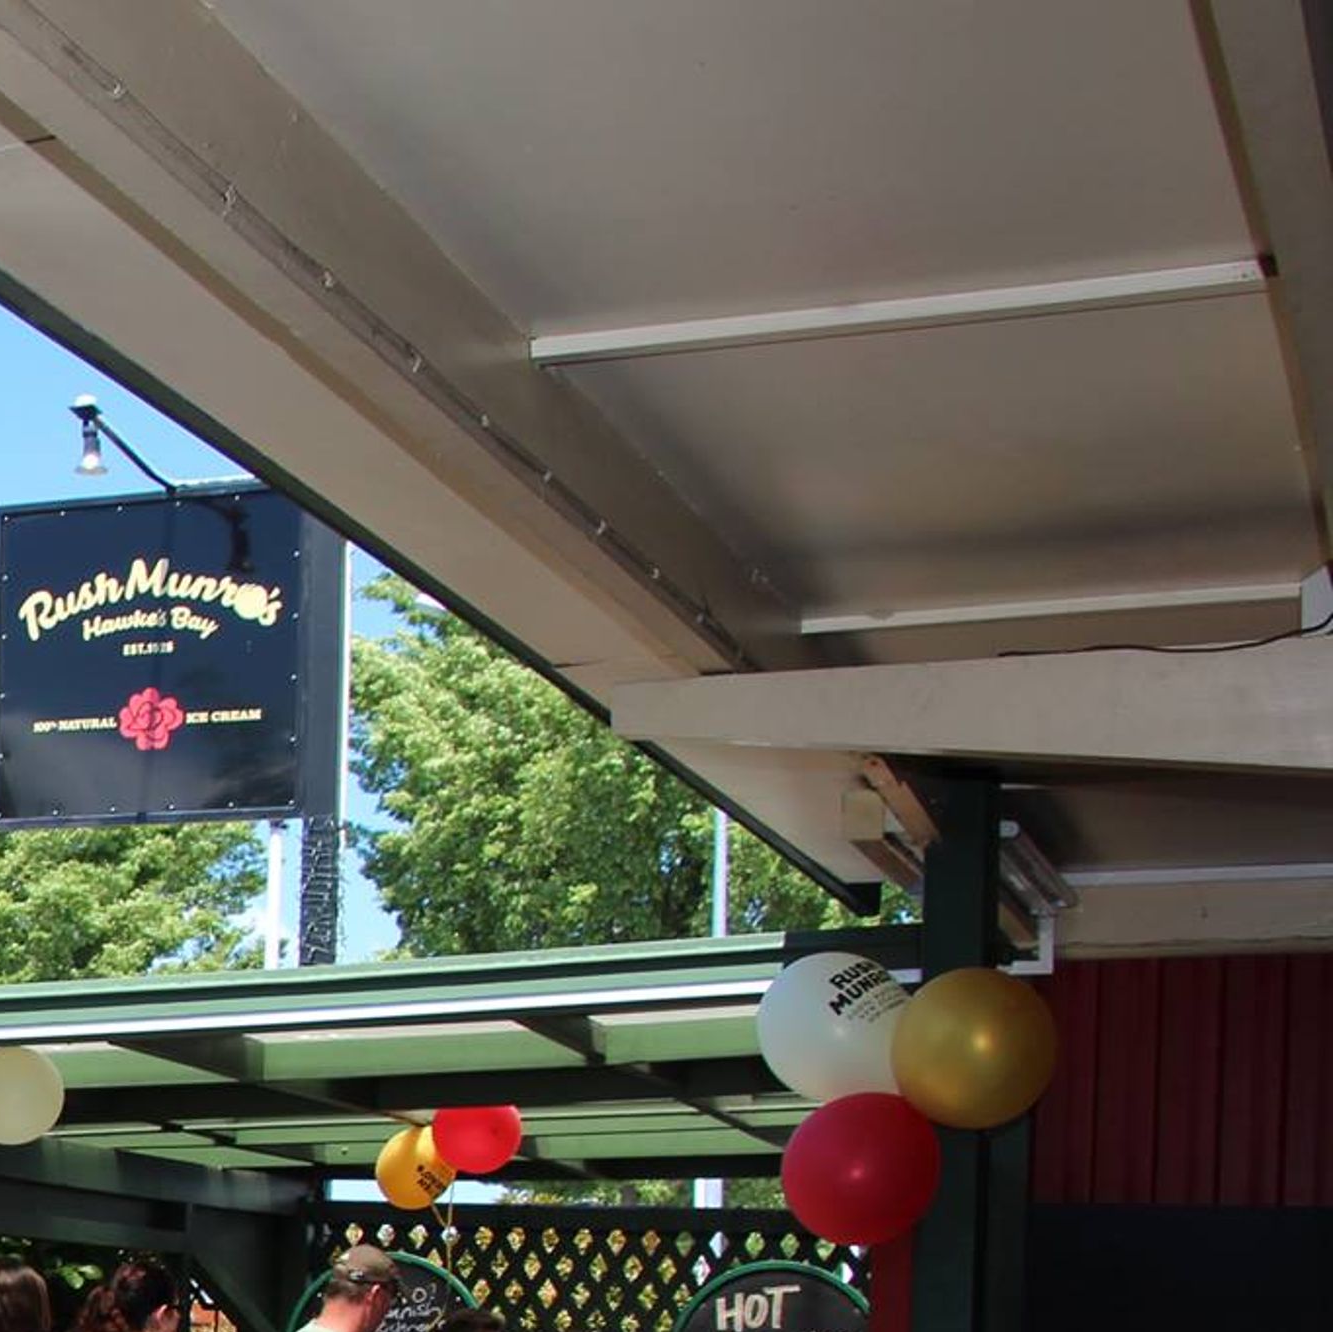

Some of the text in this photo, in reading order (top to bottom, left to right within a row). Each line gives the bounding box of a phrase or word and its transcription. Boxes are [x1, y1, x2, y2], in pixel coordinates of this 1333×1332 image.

[18, 573, 125, 642] Rush
[82, 605, 220, 641] Hawke's Bay
[58, 716, 118, 732] NATURAL
[186, 711, 209, 724] ICE
[210, 707, 262, 722] CREAM
[715, 1284, 802, 1332] HOT
